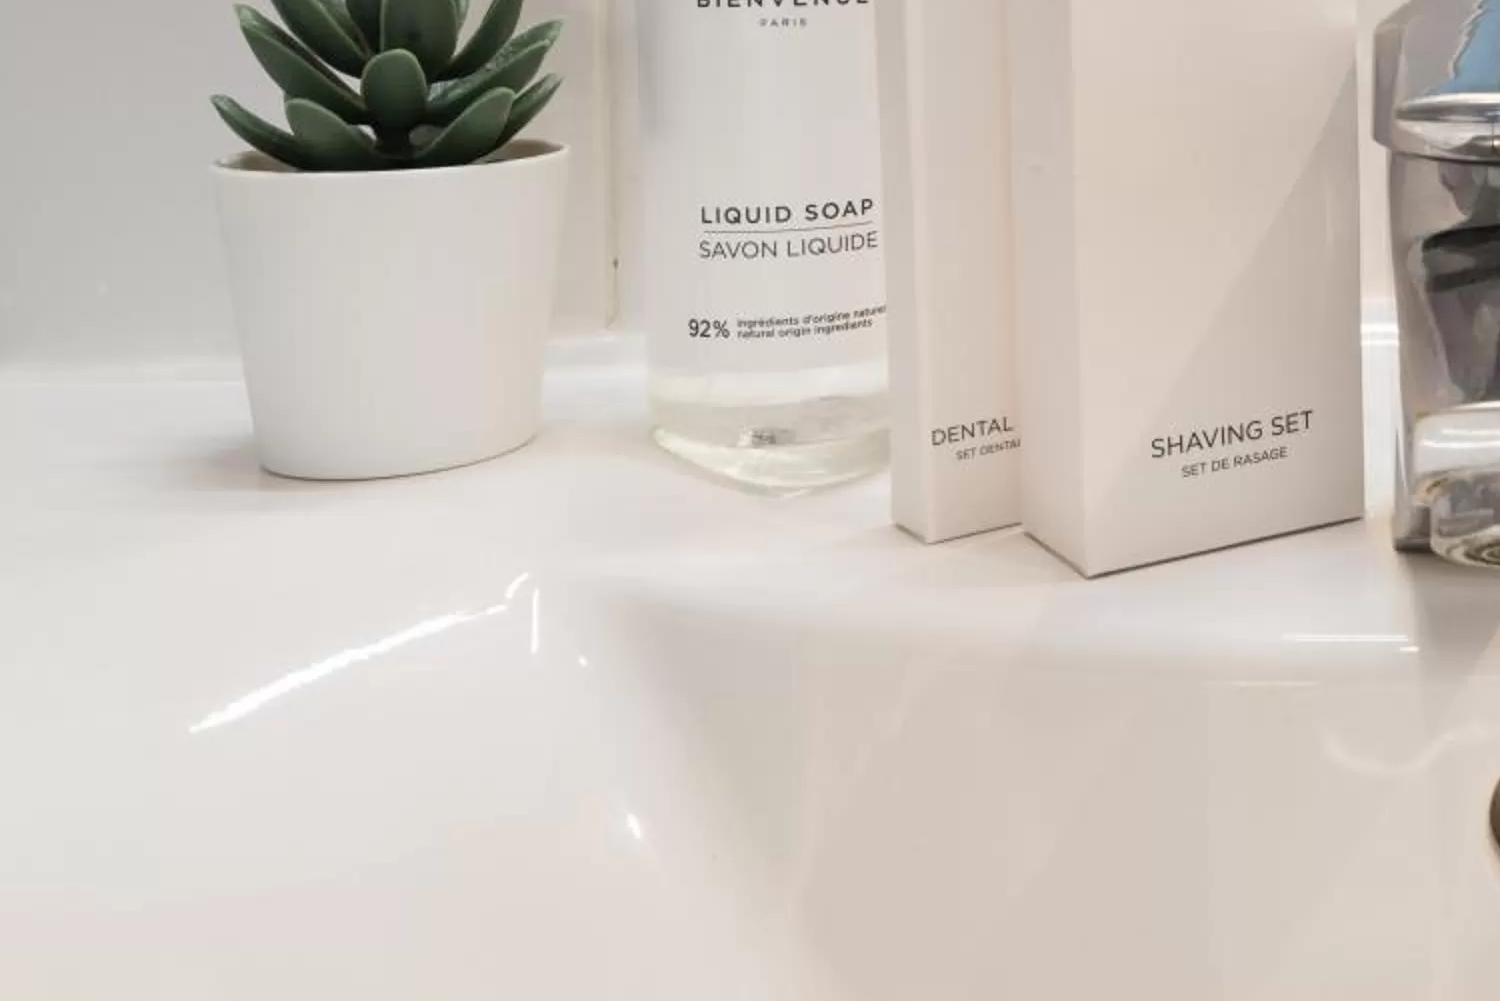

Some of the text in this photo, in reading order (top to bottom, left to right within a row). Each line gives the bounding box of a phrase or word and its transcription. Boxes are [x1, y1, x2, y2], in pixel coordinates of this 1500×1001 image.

[759, 17, 807, 28] PARIS
[701, 198, 873, 224] LIQUID SOAP
[699, 230, 878, 259] SAVON LIQUIDE
[687, 318, 731, 339] 92%
[737, 328, 775, 339] natural
[777, 326, 811, 339] origin
[931, 416, 1014, 446] DENTAL
[1150, 409, 1315, 459] SHAVING SET
[1181, 446, 1288, 478] SET DE RASAGE
